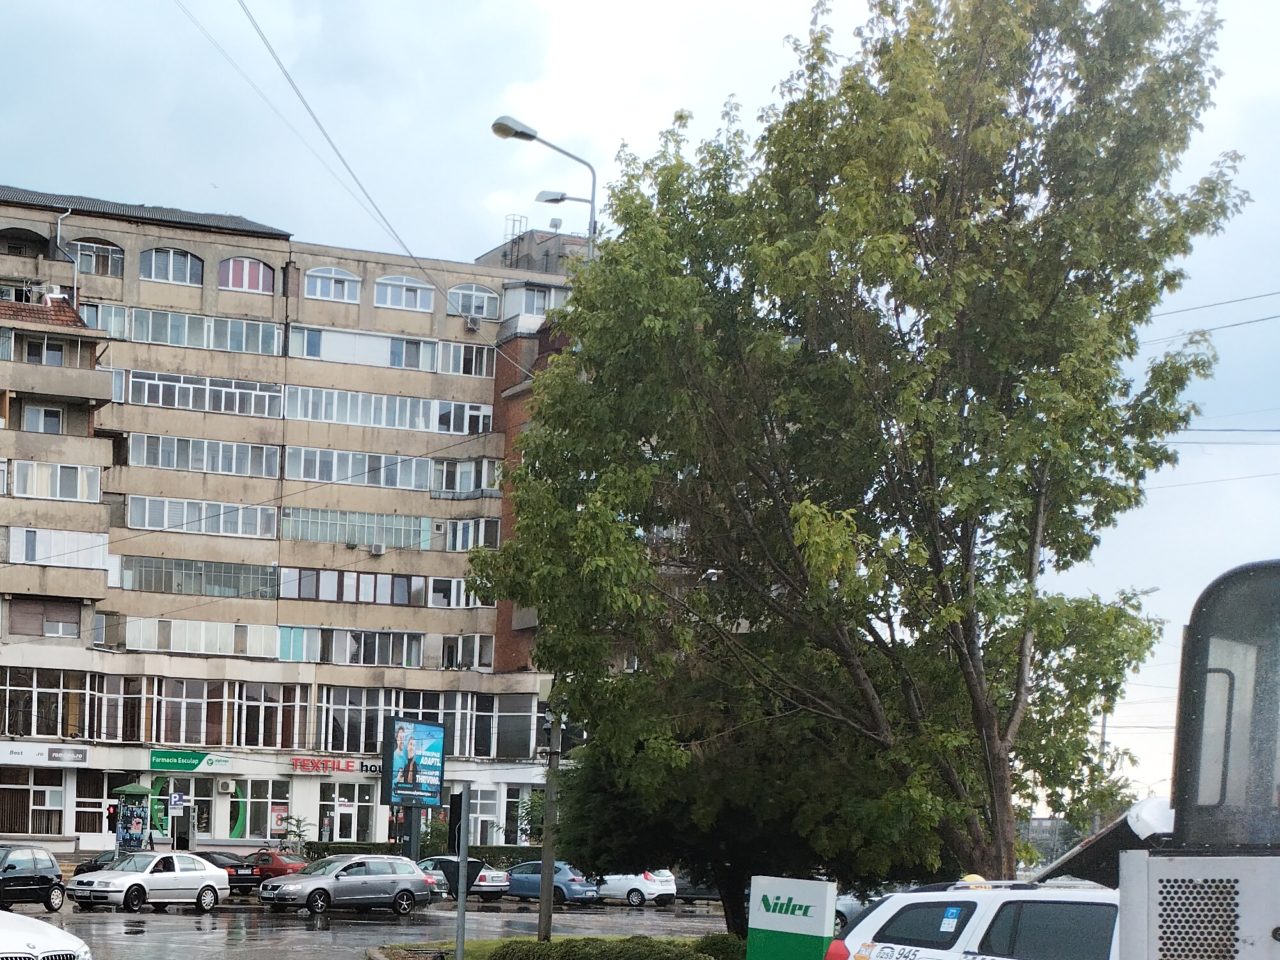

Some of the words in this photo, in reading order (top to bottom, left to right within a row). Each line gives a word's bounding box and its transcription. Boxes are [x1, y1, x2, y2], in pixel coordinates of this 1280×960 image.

[177, 757, 199, 765] Esculap
[291, 758, 355, 773] TEXTILE
[758, 894, 816, 917] Nidec
[895, 947, 920, 960] 945
